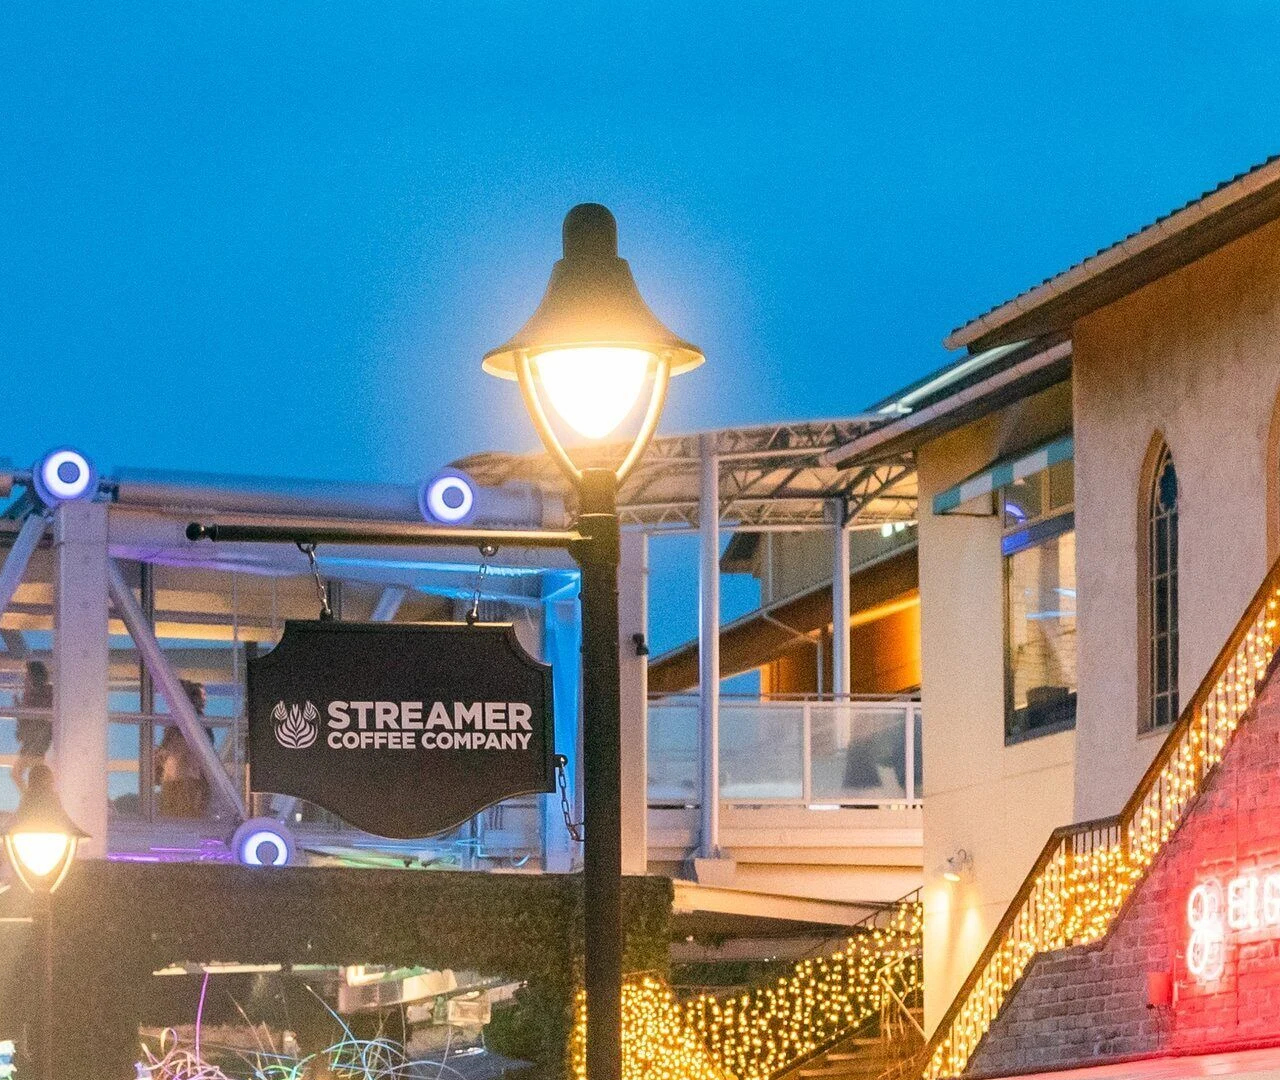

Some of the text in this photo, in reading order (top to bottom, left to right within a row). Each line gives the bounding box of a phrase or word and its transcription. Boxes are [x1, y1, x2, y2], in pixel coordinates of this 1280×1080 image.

[327, 701, 532, 730] STREAMER
[327, 731, 532, 750] COFFEE COMPANY
[1187, 878, 1224, 978] 8
